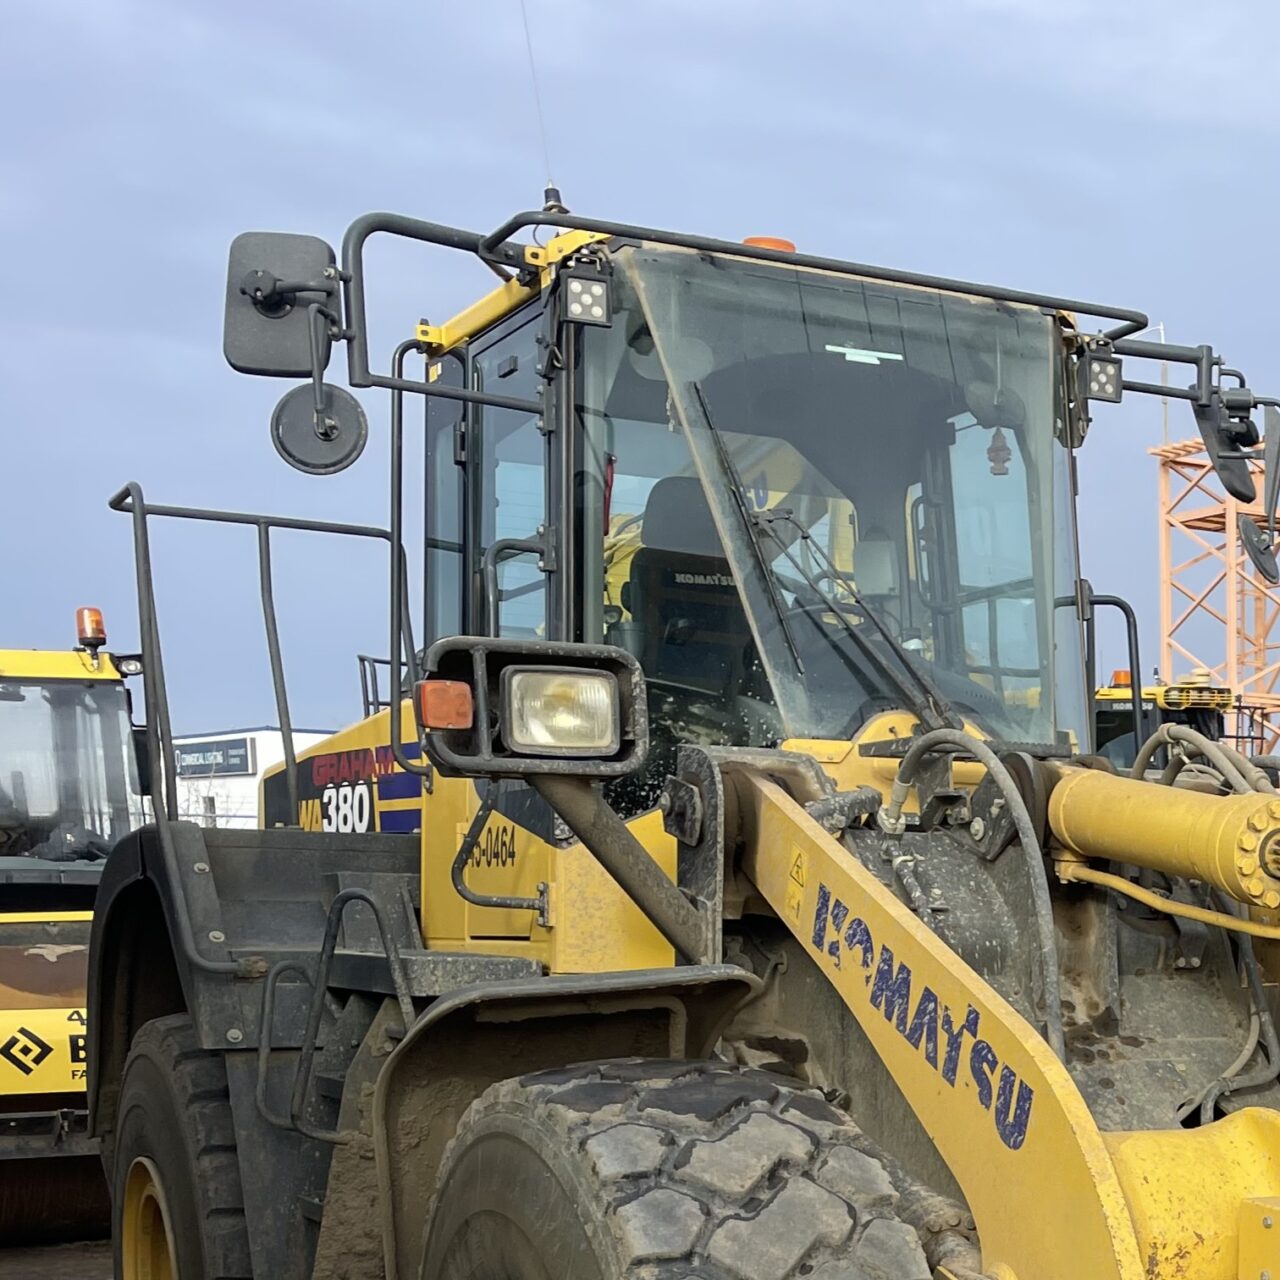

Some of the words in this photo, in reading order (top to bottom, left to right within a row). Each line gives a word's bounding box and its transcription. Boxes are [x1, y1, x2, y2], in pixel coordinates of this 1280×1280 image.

[674, 572, 737, 586] KOMATSU
[1112, 702, 1154, 711] KOMSU
[312, 746, 398, 786] GRAHAM
[322, 779, 370, 833] 380
